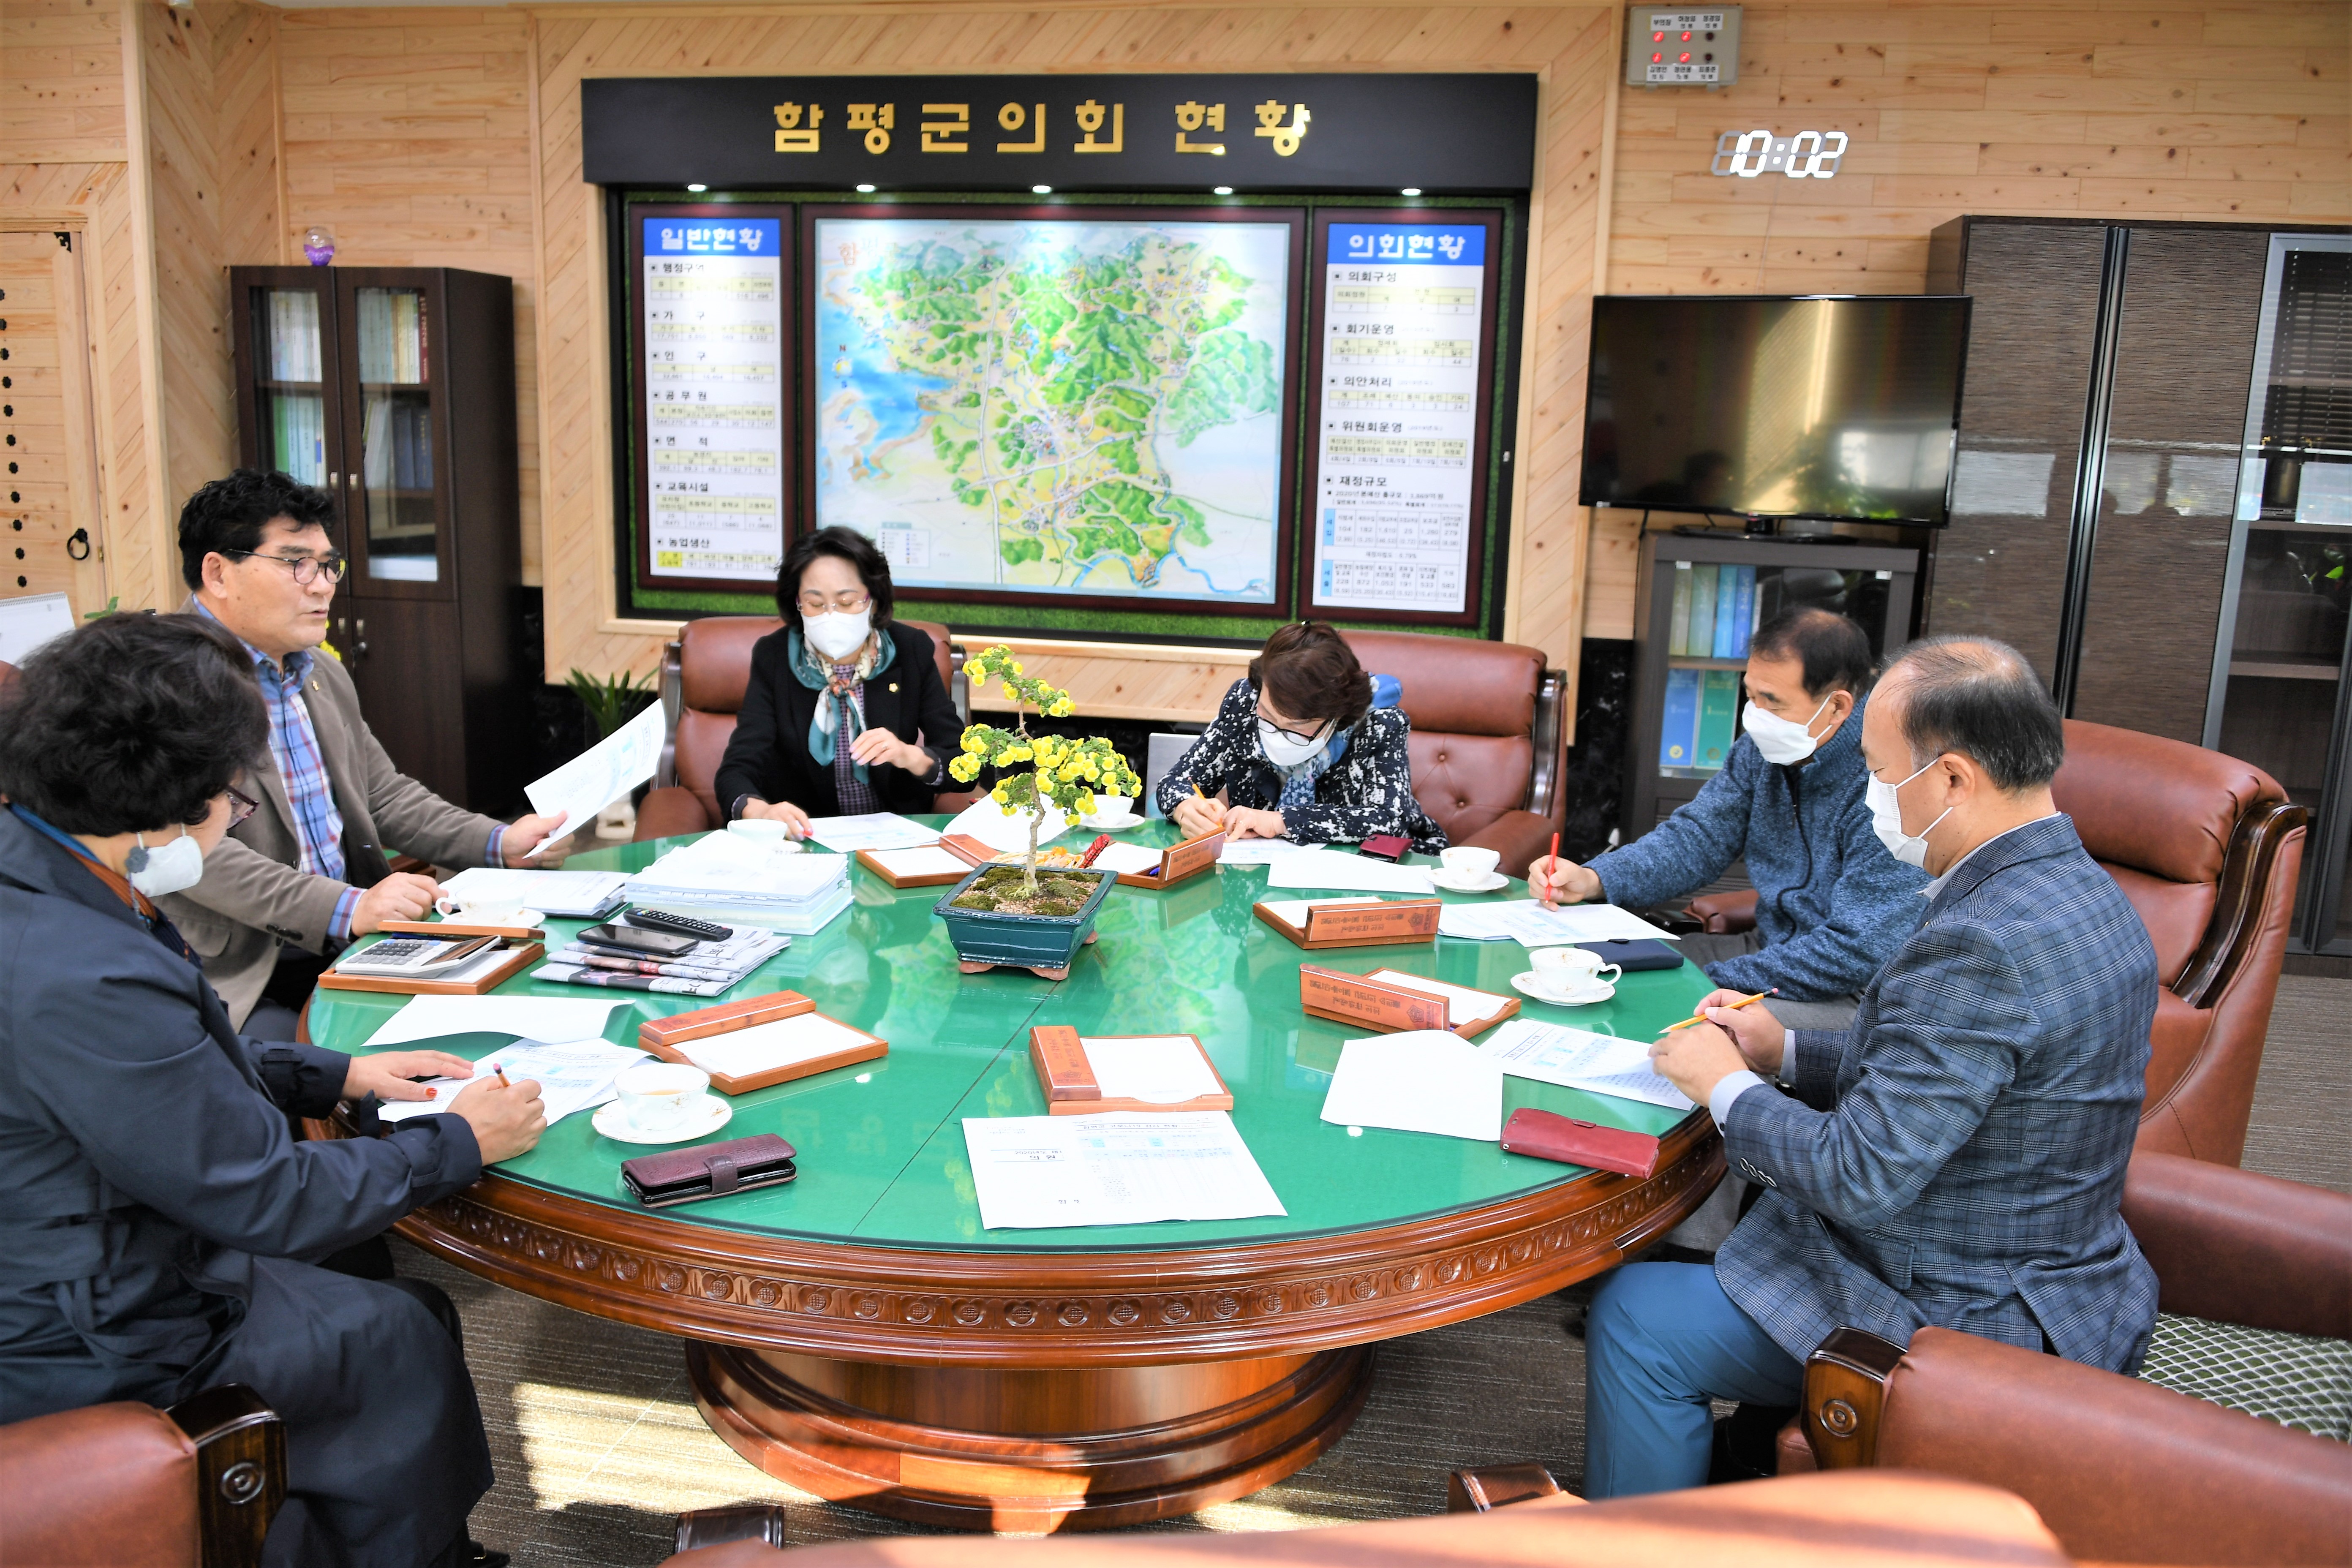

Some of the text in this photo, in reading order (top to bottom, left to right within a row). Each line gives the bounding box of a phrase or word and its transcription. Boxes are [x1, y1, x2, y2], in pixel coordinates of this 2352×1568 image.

[773, 99, 1311, 157] 함평군의회 현황
[1730, 130, 1848, 178] 10:02
[661, 228, 763, 251] 일반현황
[1348, 234, 1466, 259] 의회현황
[1348, 272, 1396, 282] 의회구성
[1346, 324, 1394, 334] 회기운영
[665, 351, 705, 361] 인 구
[1344, 376, 1391, 387] 의안처리
[1342, 421, 1402, 433] 위원회운영
[668, 482, 708, 492] 교육시설
[1339, 476, 1387, 487] 재정규모
[669, 537, 710, 548] 농업생산
